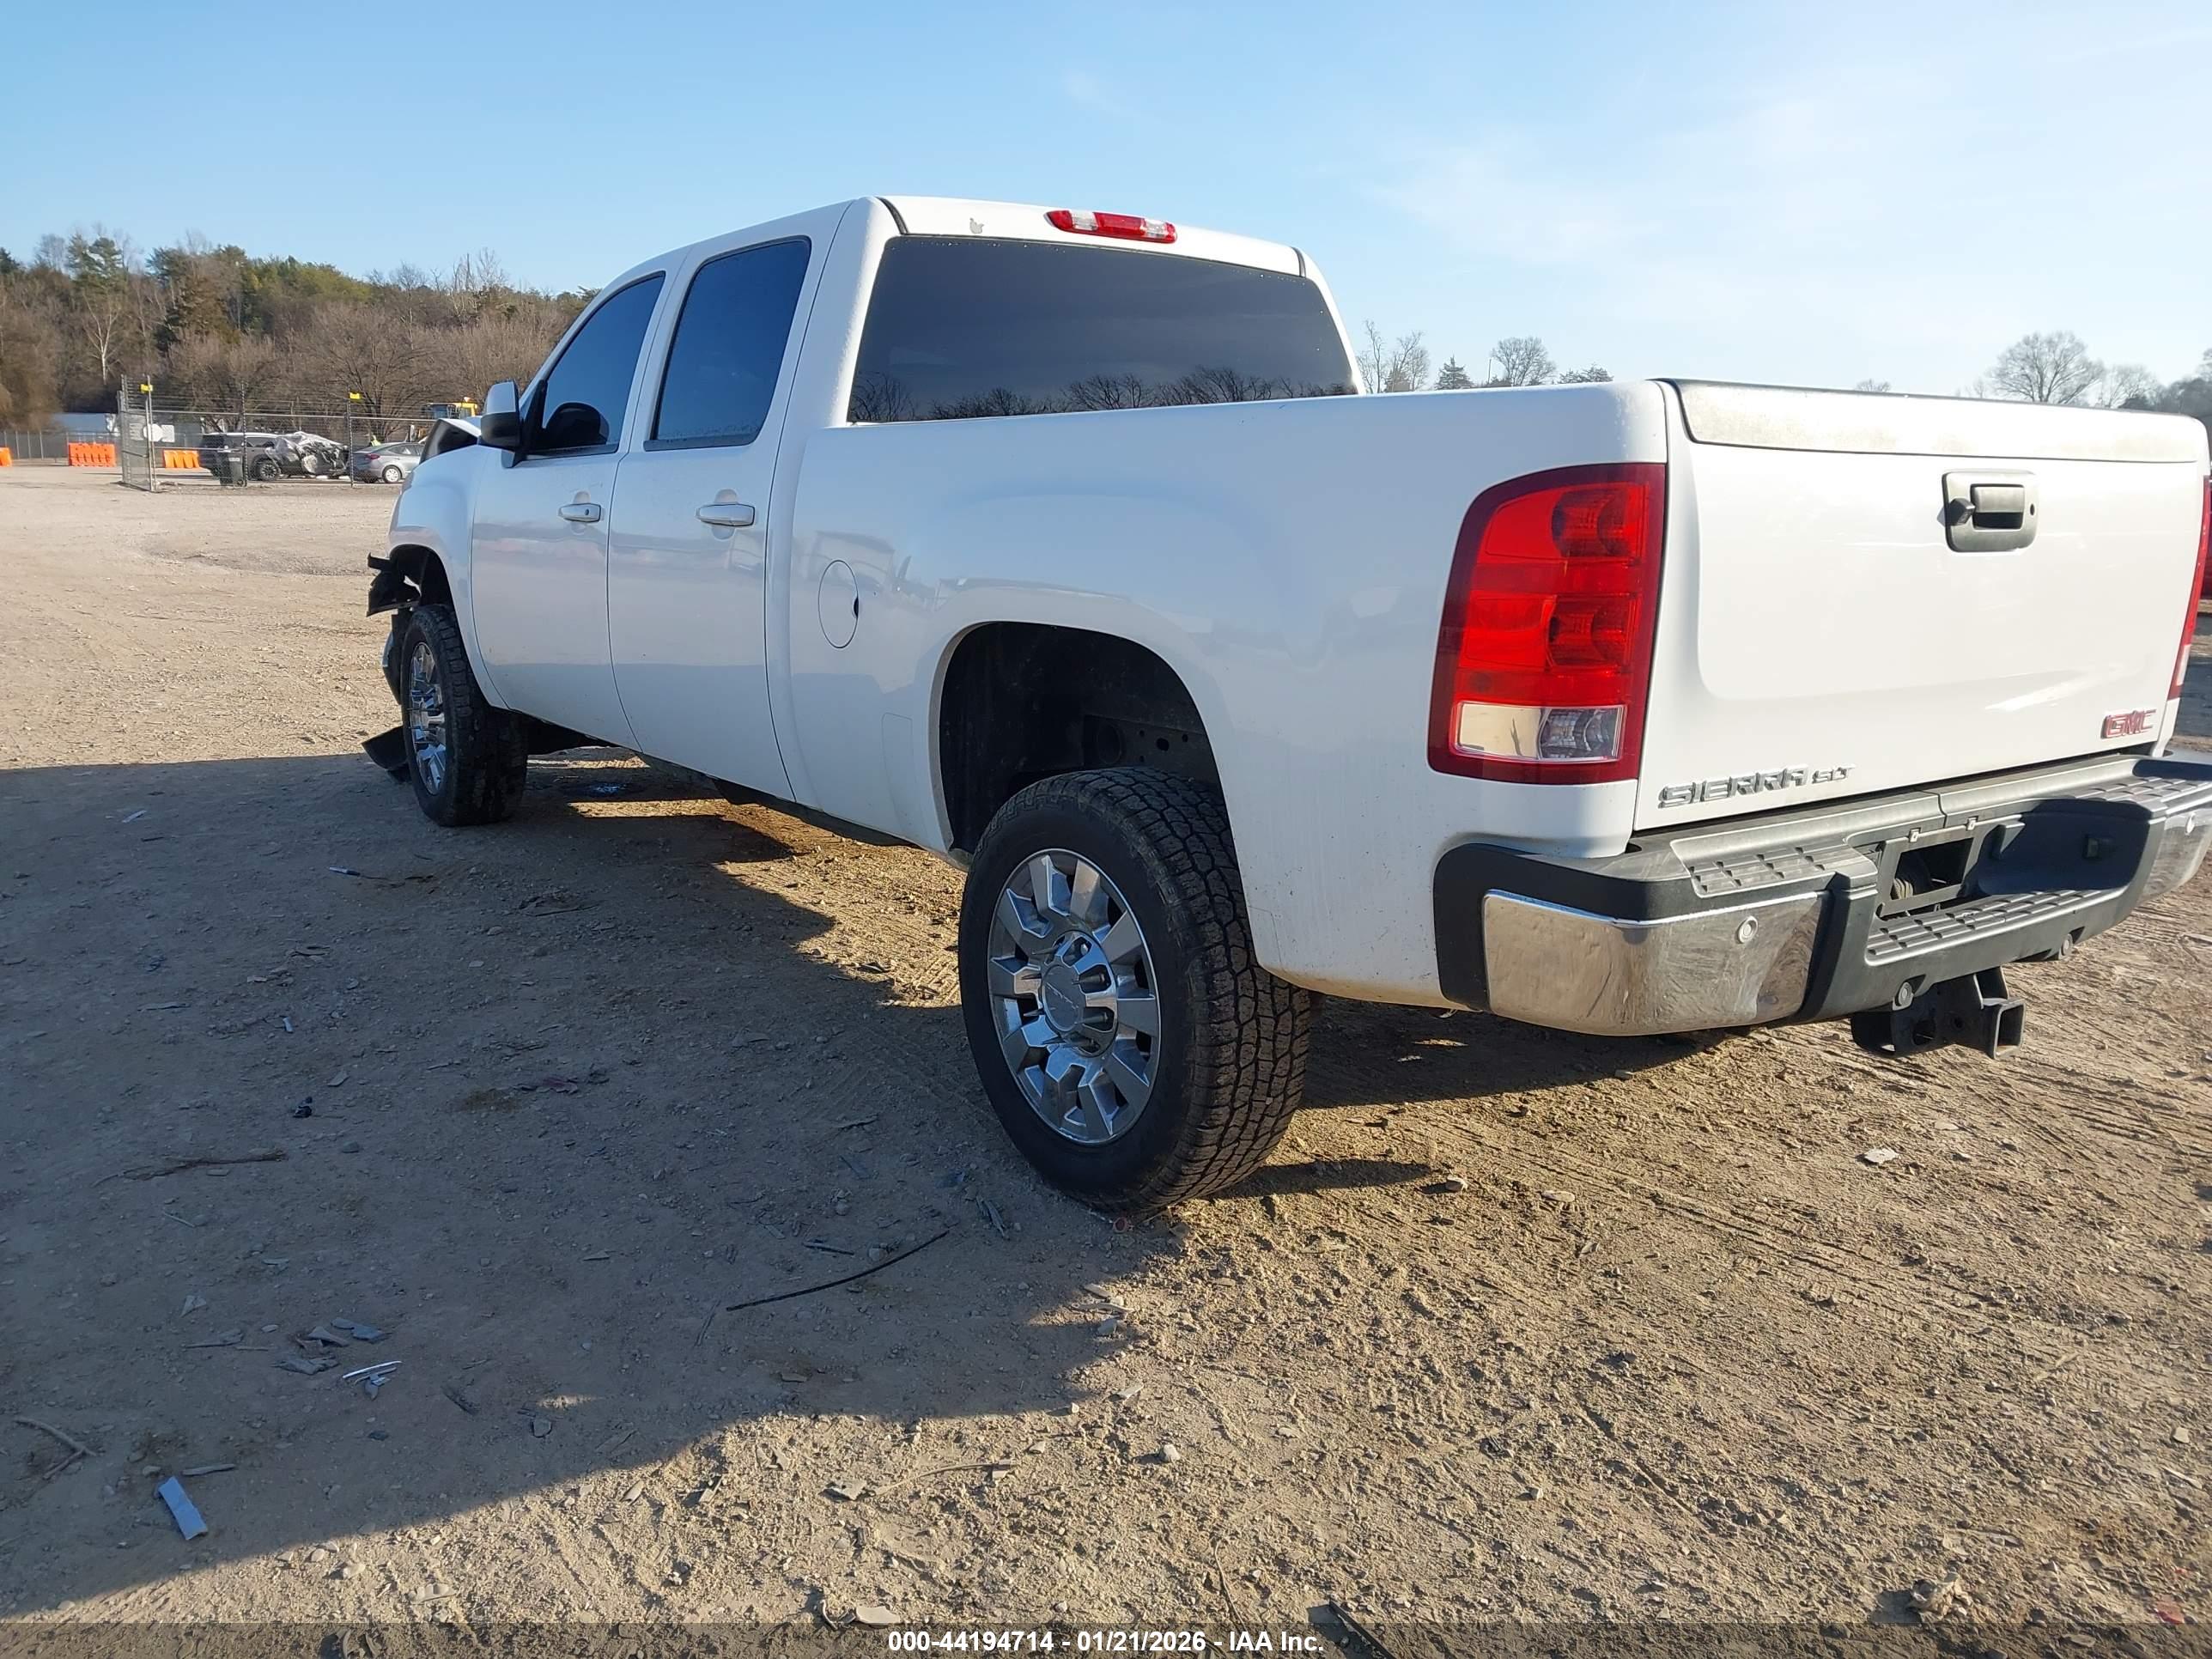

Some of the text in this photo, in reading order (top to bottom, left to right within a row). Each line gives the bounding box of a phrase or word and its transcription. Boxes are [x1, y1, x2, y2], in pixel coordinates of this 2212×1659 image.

[2100, 709, 2157, 738] GMC
[1658, 764, 1856, 809] SIERRA SLT
